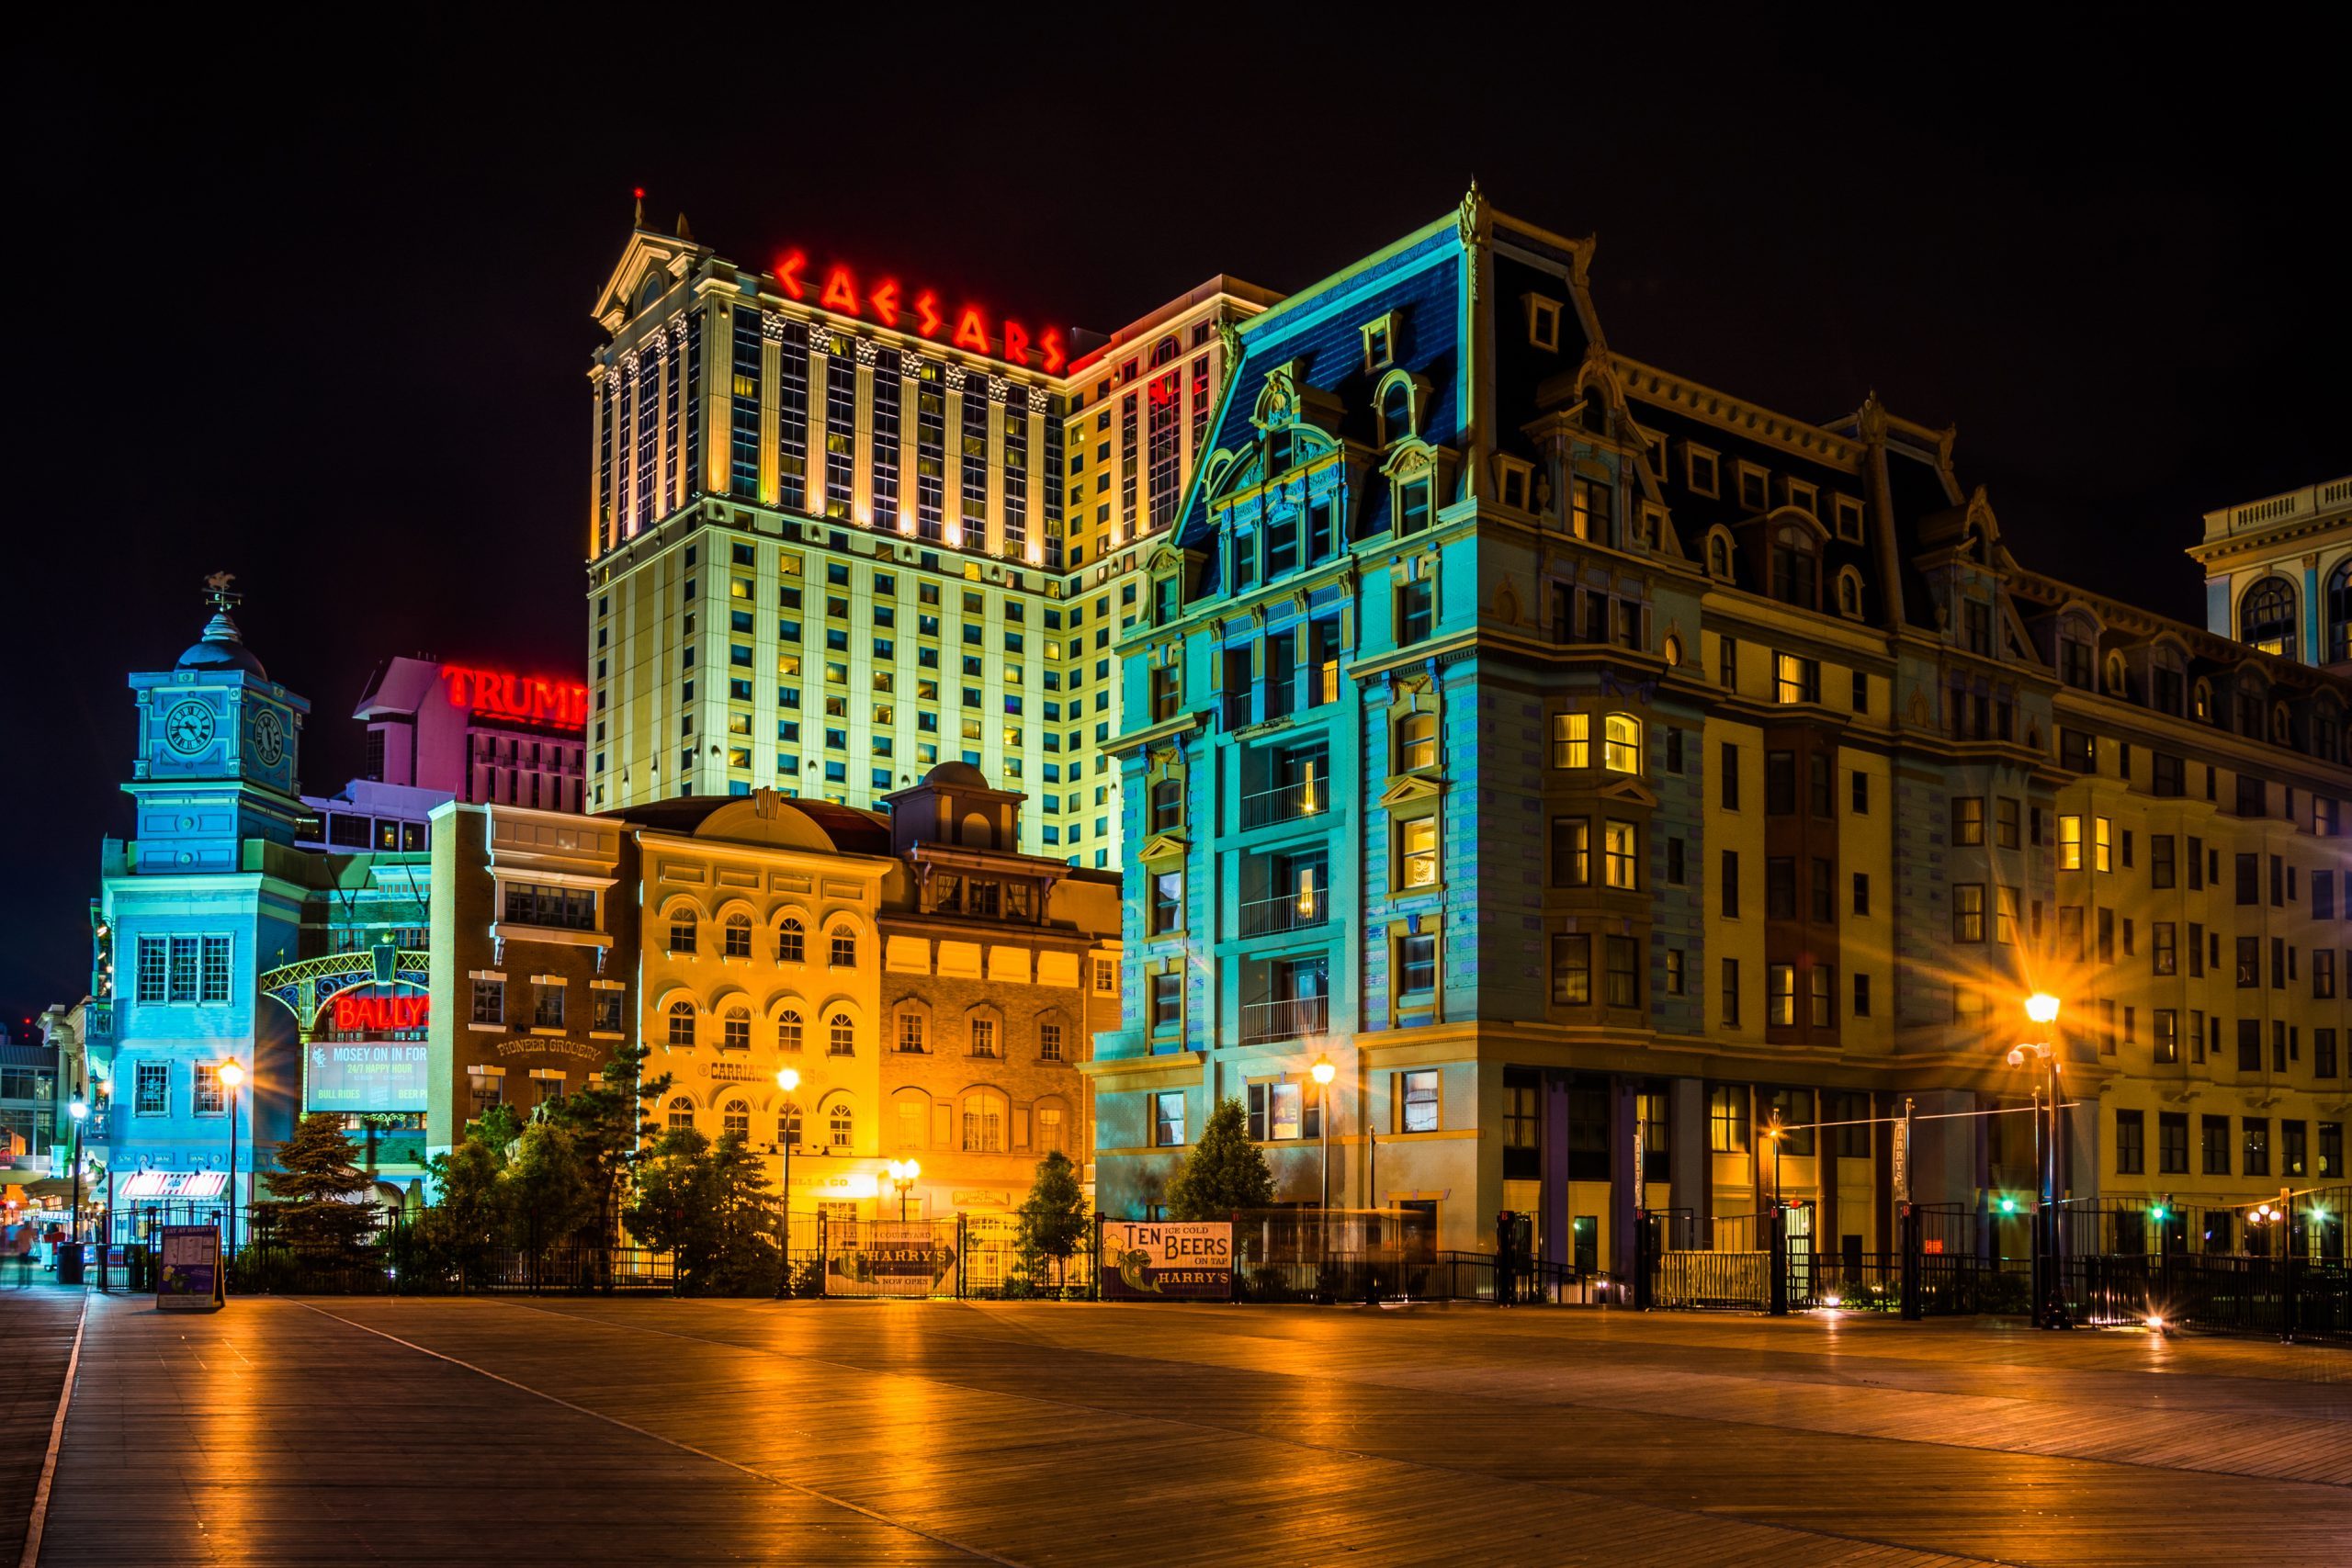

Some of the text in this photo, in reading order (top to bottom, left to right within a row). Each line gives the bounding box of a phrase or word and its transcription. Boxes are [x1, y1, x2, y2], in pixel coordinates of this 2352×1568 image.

[776, 254, 1064, 372] CAESARS
[334, 1048, 427, 1061] MOSEY ON IN FOR
[497, 1038, 602, 1061] PIONEER GROCERY
[347, 1064, 413, 1073] 24/7 HAPPY HOUR
[318, 1089, 336, 1099] BULL
[338, 1089, 360, 1099] RIDES
[398, 1089, 417, 1099] BEER
[879, 1231, 931, 1239] COURTYARD
[1124, 1224, 1161, 1249] TEN
[1164, 1235, 1227, 1260] BEERS
[869, 1250, 947, 1262] HARRY'S
[882, 1278, 929, 1286] NOW OPEN
[1158, 1272, 1228, 1284] HARRY'S
